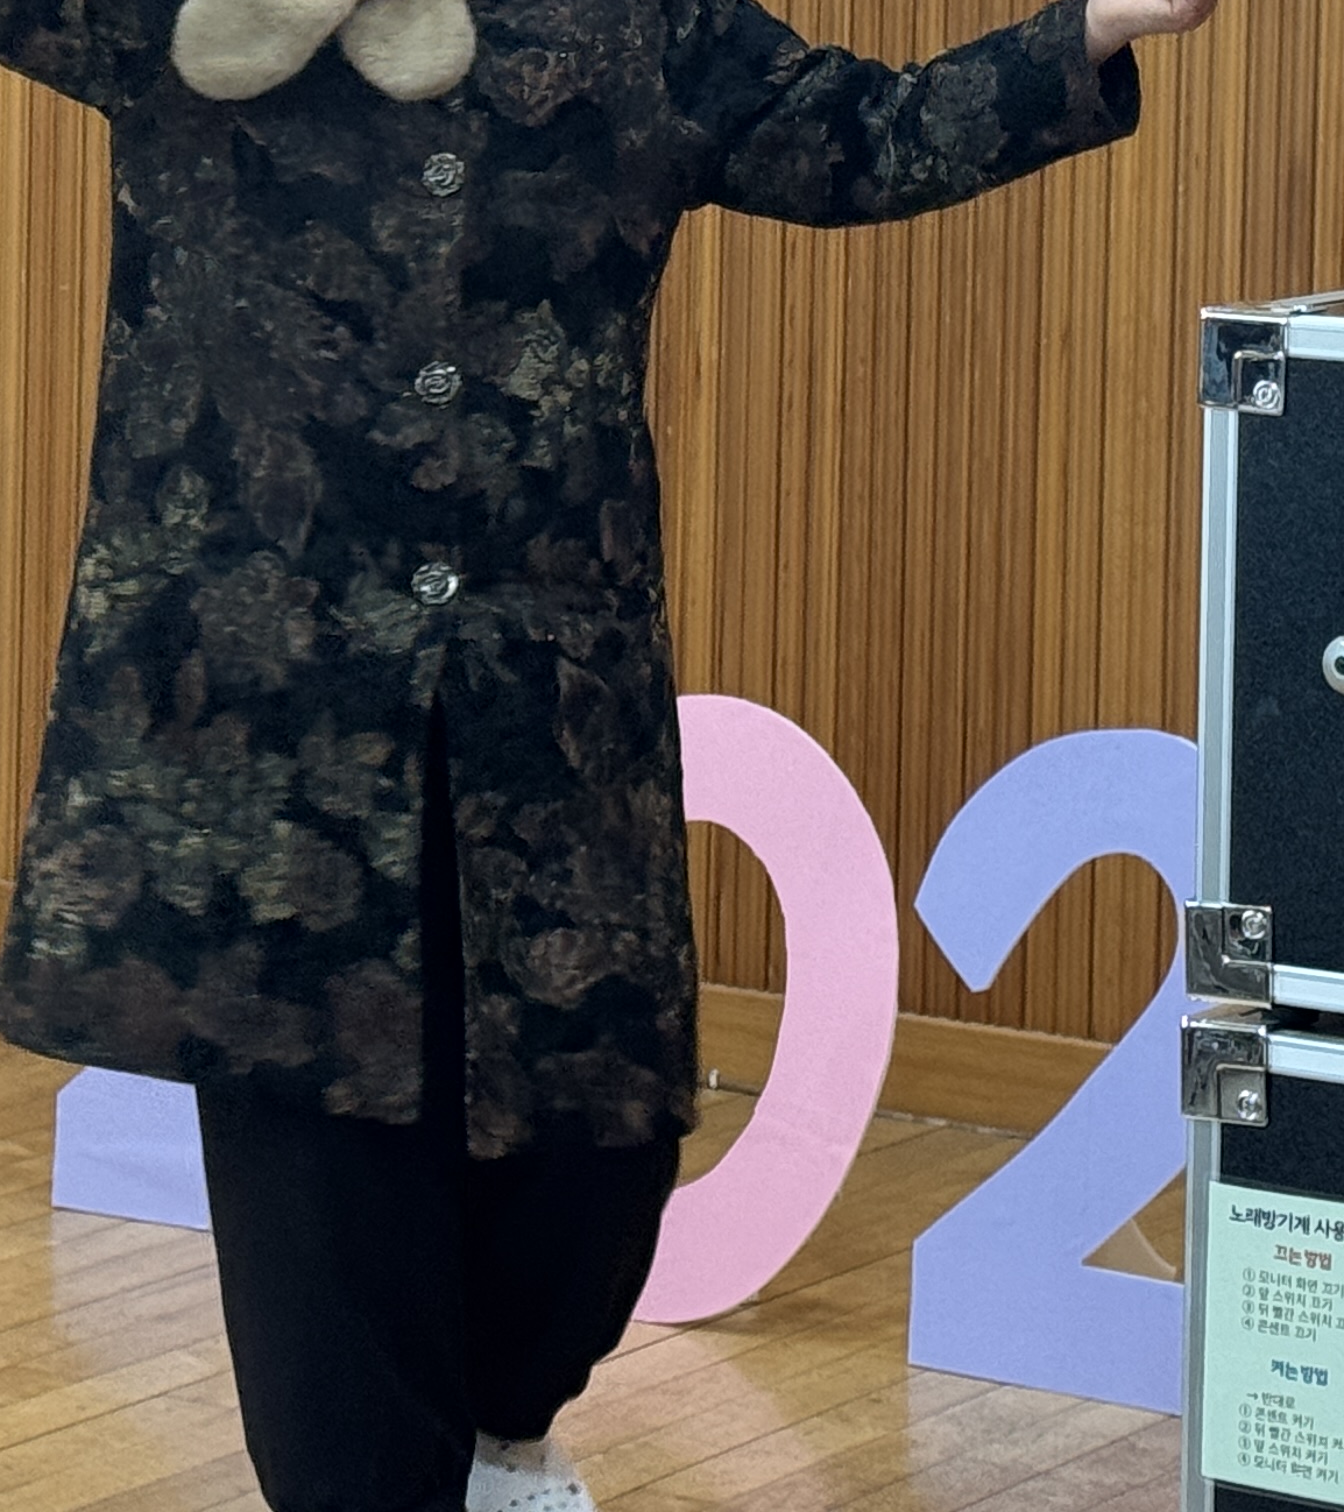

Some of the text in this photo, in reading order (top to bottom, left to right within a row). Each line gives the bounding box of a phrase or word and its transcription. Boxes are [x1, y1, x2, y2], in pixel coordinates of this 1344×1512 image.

[1229, 1204, 1310, 1235] 노래방기계
[1258, 1270, 1292, 1289] 모니터
[1273, 1290, 1306, 1308] 스위치
[1298, 1310, 1332, 1328] 스위치
